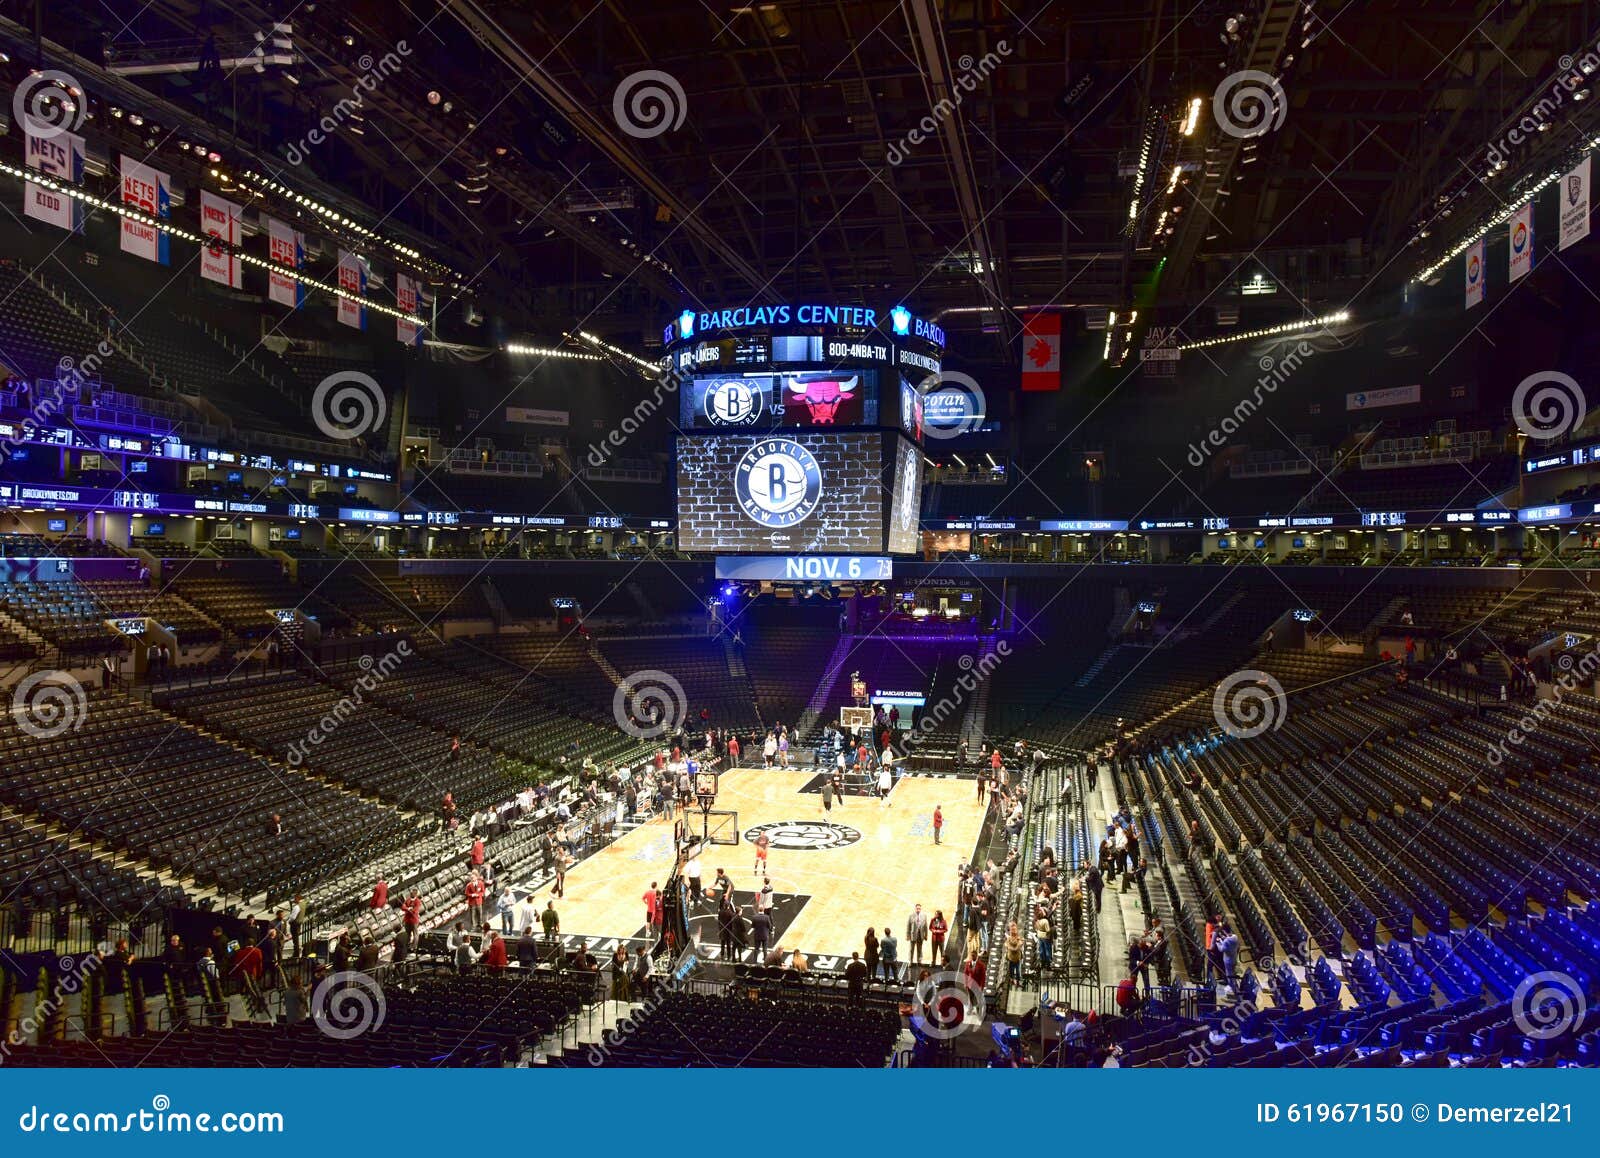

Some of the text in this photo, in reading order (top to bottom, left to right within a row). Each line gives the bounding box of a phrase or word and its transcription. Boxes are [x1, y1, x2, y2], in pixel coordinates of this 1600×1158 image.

[30, 136, 66, 168] NETS
[124, 175, 154, 201] NETS
[36, 191, 60, 211] KIDD
[203, 204, 225, 224] NETS
[123, 221, 154, 242] WILLIAMS
[271, 236, 294, 257] NETS
[340, 266, 358, 284] NETS
[700, 304, 877, 331] BARCLAYS CENTER
[695, 347, 720, 363] LAKERS
[829, 342, 887, 360] 800-4NBA-TIX
[728, 388, 740, 416] B
[769, 404, 785, 415] VS
[741, 442, 815, 472] BROOKLYN
[769, 463, 787, 504] B
[744, 499, 813, 524] NEW YORK
[786, 558, 841, 578] NOV.
[849, 558, 861, 578] 6
[914, 578, 956, 586] HONDA
